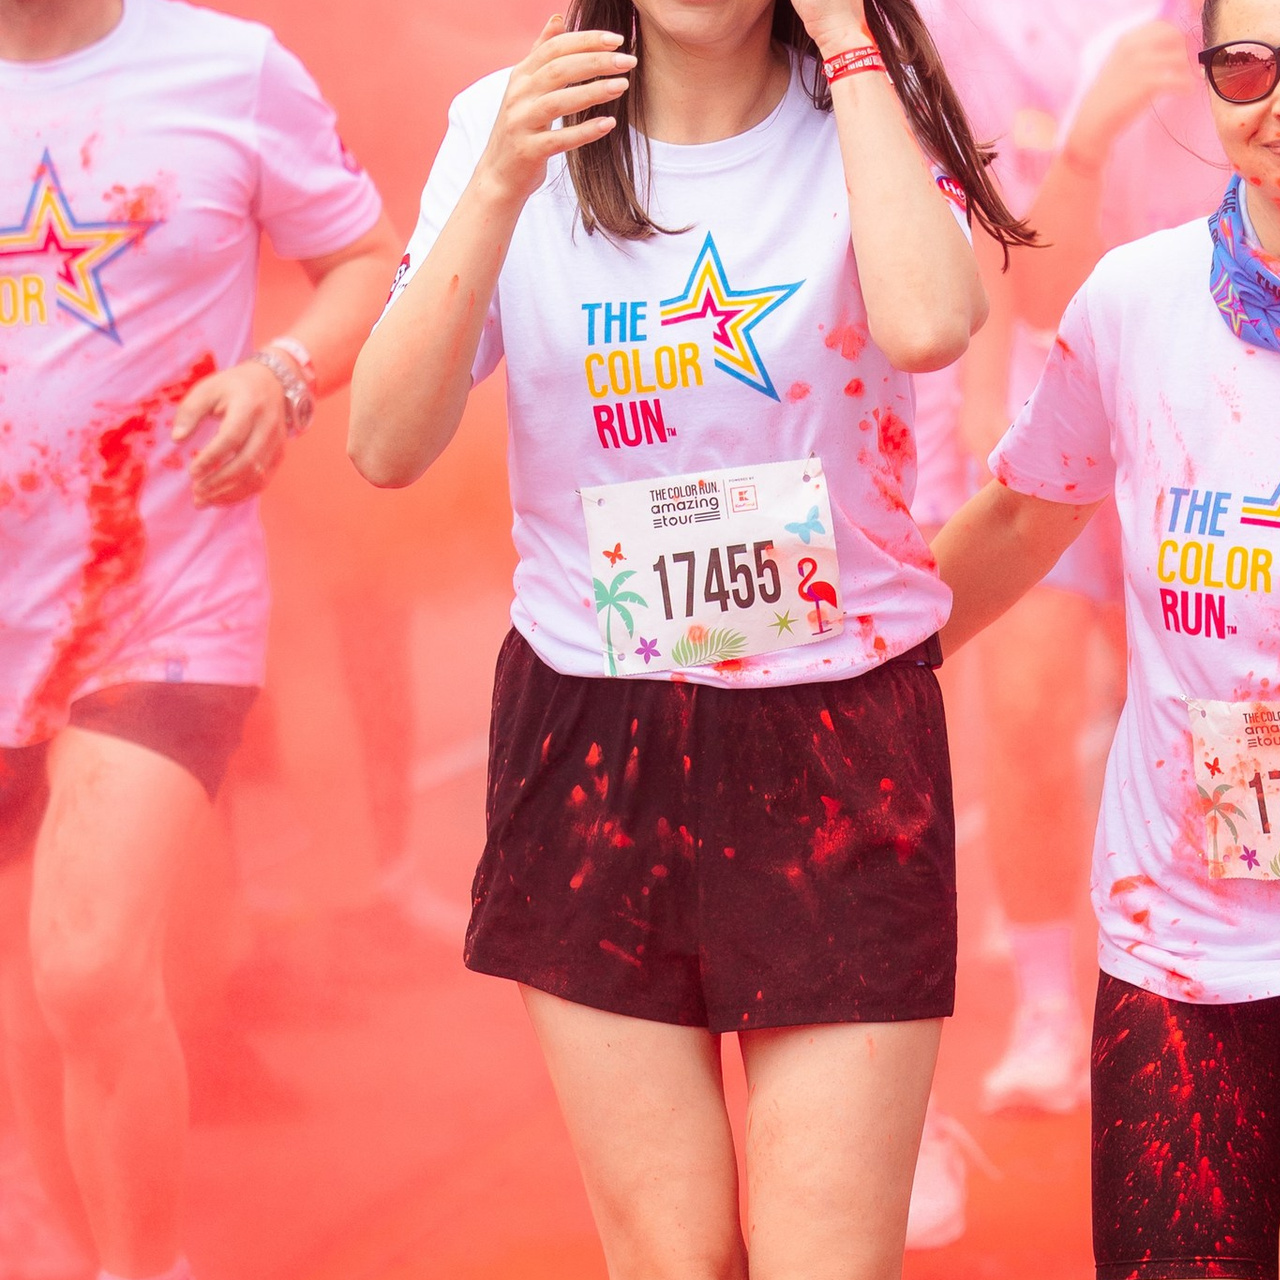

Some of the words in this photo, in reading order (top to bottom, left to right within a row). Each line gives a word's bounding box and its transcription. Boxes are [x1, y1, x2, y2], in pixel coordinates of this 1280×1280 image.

[581, 301, 648, 346] THE
[585, 343, 704, 399] COLOR
[649, 488, 667, 502] THE
[667, 484, 698, 499] COLOR
[651, 496, 719, 515] amazing
[1167, 486, 1230, 537] THE
[662, 514, 693, 527] tour
[652, 539, 782, 621] 17455
[1157, 539, 1273, 593] COLOR
[1243, 713, 1259, 724] THE
